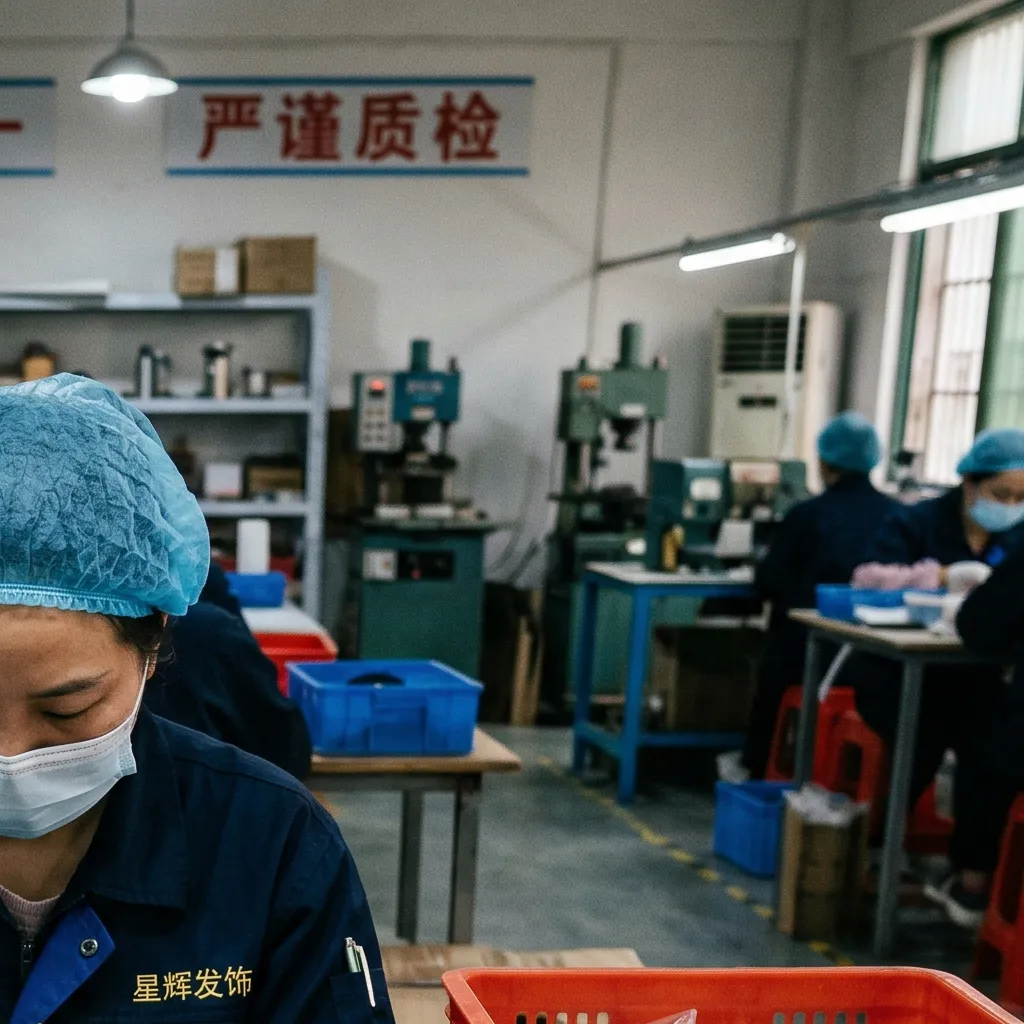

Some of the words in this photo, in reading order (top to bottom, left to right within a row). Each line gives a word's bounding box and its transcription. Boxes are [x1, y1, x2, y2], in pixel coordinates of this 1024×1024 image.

[197, 91, 502, 163] 严谨质检
[132, 965, 253, 1002] 星辉发饰
